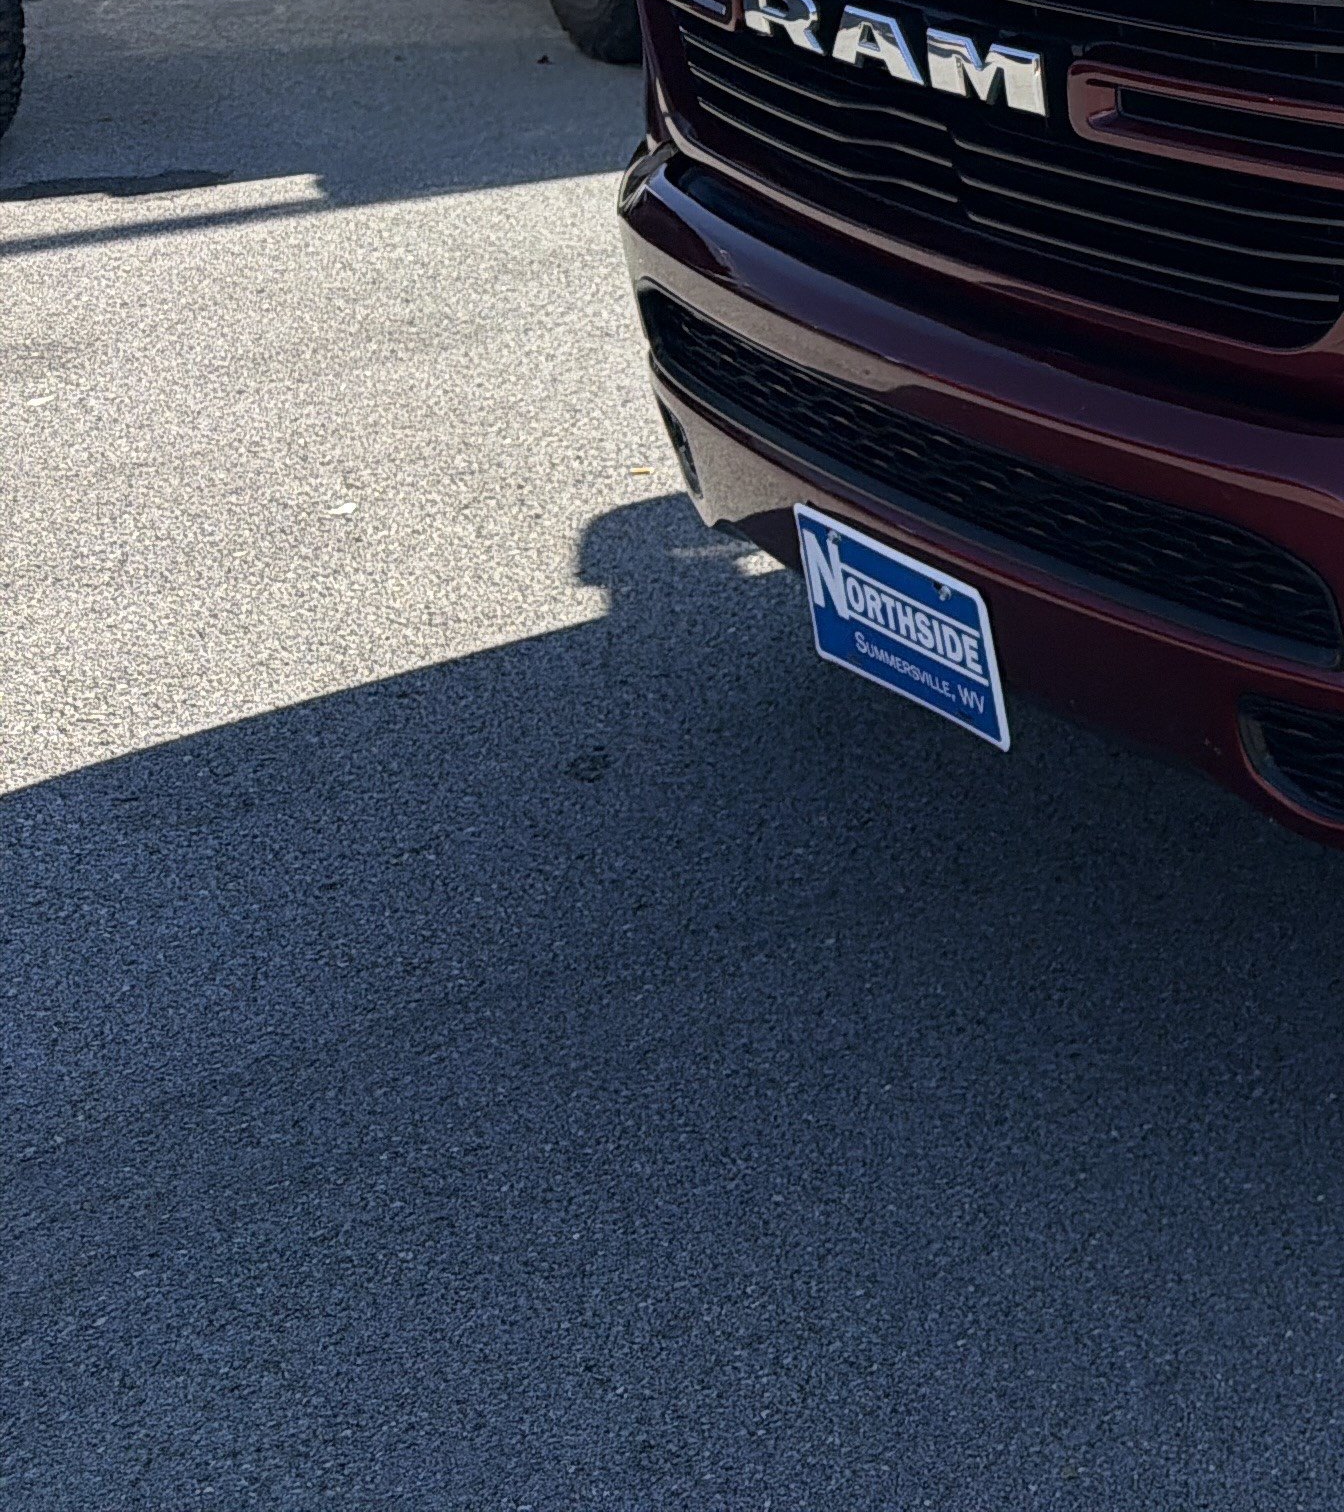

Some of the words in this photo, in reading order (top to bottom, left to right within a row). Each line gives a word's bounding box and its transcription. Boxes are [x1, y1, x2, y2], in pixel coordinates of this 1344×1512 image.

[803, 529, 984, 675] NORTHSIDE
[854, 631, 956, 701] SUMMERSVILLE,
[957, 684, 985, 715] WV
